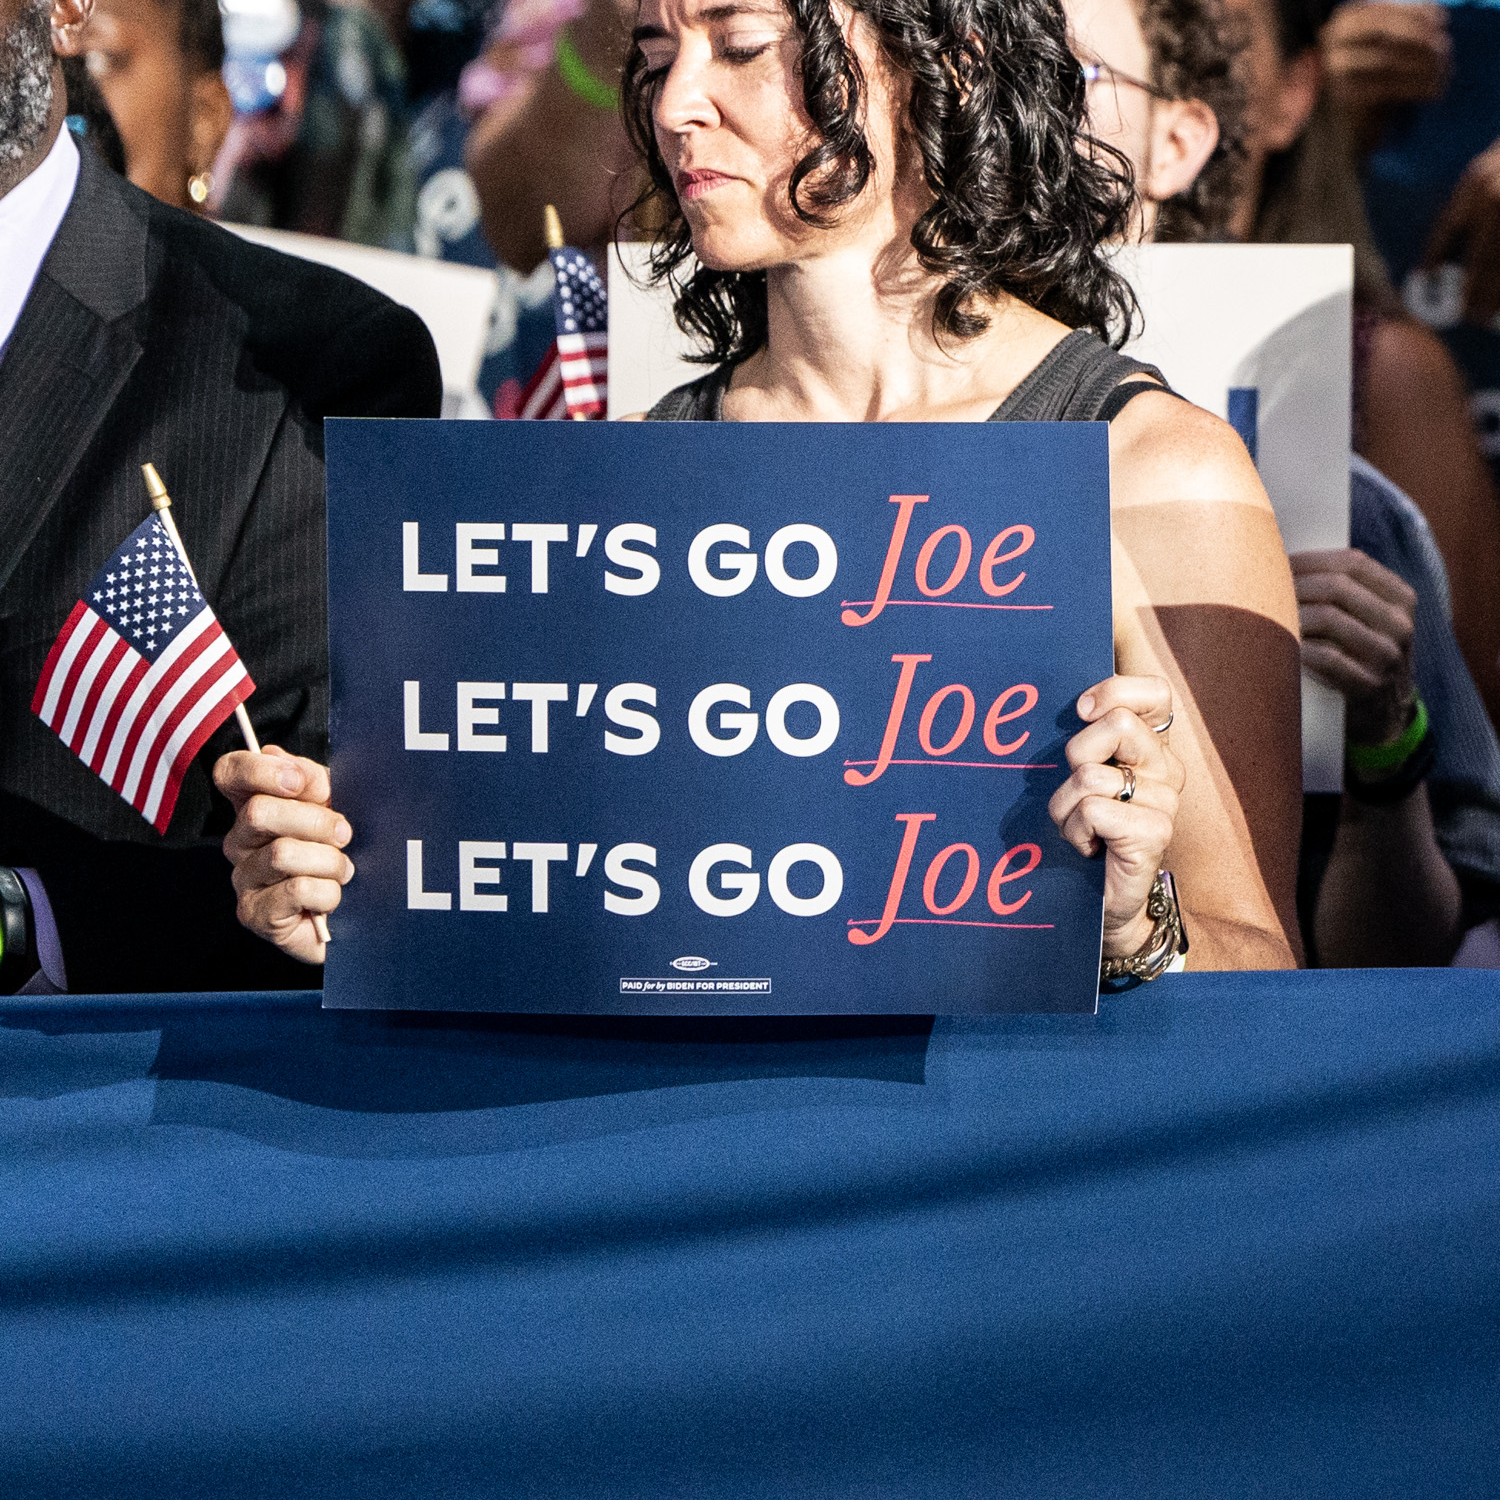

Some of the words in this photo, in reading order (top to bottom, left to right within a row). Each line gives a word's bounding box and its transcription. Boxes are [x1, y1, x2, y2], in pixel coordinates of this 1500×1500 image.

[402, 522, 661, 596] LET'S
[688, 524, 838, 597] GO
[841, 494, 1046, 627] Joe
[404, 681, 661, 756] LET'S
[688, 683, 841, 757] GO
[844, 654, 1046, 786] Joe
[407, 840, 661, 916] LET'S
[689, 843, 844, 917] GO
[848, 813, 1048, 946] Joe
[622, 981, 643, 990] PAID
[643, 981, 656, 991] for
[656, 982, 666, 991] by
[666, 981, 695, 990] BIDEN
[696, 981, 715, 990] FOR
[716, 981, 769, 990] PRESIDENT
